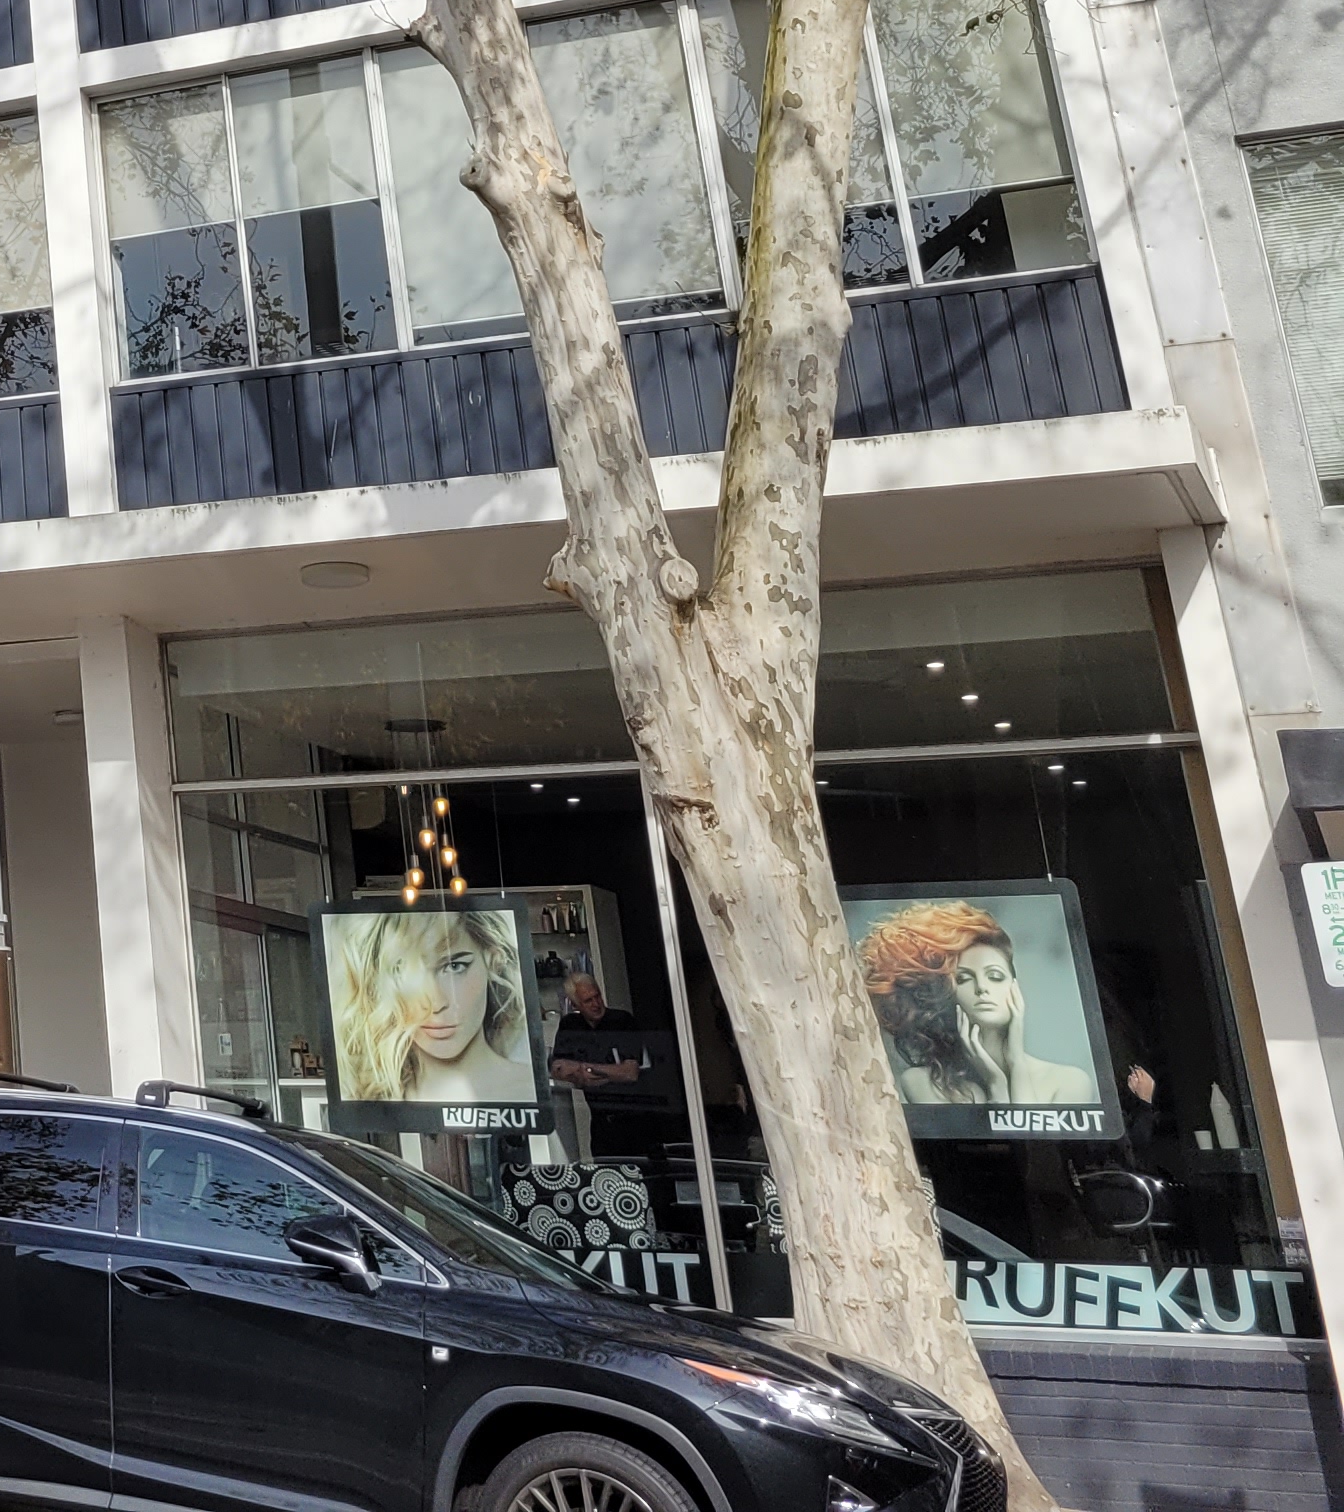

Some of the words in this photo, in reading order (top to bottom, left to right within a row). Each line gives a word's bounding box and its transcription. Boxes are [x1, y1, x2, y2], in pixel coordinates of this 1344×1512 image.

[442, 1107, 540, 1128] RUFFKUT
[988, 1110, 1105, 1131] RUFFKUT
[945, 1260, 1304, 1336] RUFFKUT
